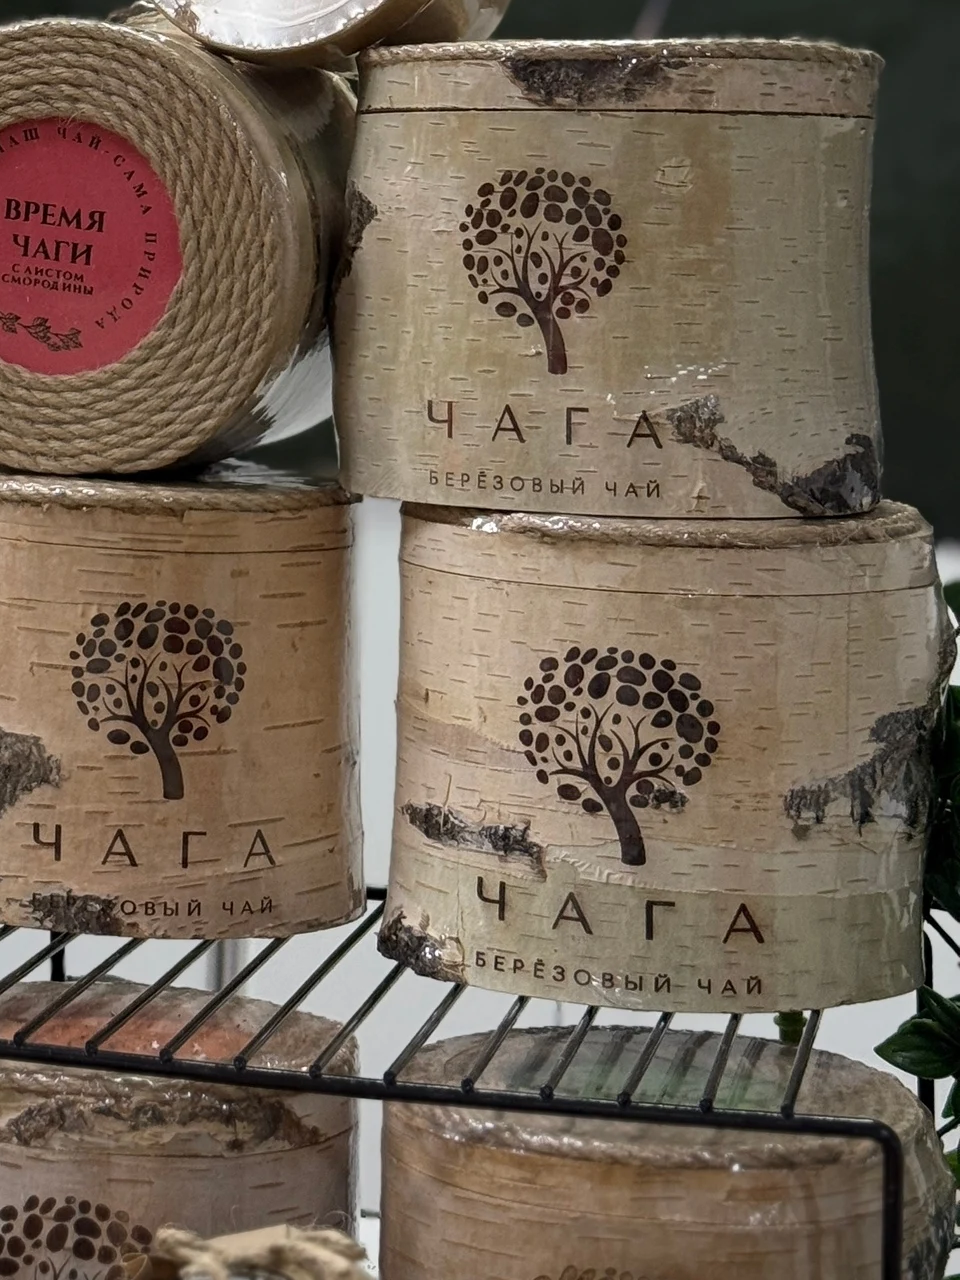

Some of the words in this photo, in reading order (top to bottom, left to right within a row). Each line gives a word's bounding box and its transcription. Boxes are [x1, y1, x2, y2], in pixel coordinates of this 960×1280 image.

[3, 197, 107, 234] ВРЕМЯ
[11, 232, 94, 267] ЧАГИ
[0, 273, 94, 296] СМОРОДИНЫ
[93, 231, 158, 330] ПРИРОДА
[426, 399, 664, 450] ЧАГА
[428, 470, 586, 496] БЕРЁЗОВЫЙ
[604, 477, 662, 499] ЧАЙ
[32, 822, 277, 869] ЧАГА
[221, 896, 274, 916] ЧАЙ
[476, 875, 765, 945] ЧАГА
[474, 951, 673, 994] БЕРЁЗОВЫЙ
[696, 974, 763, 996] ЧАЙ
